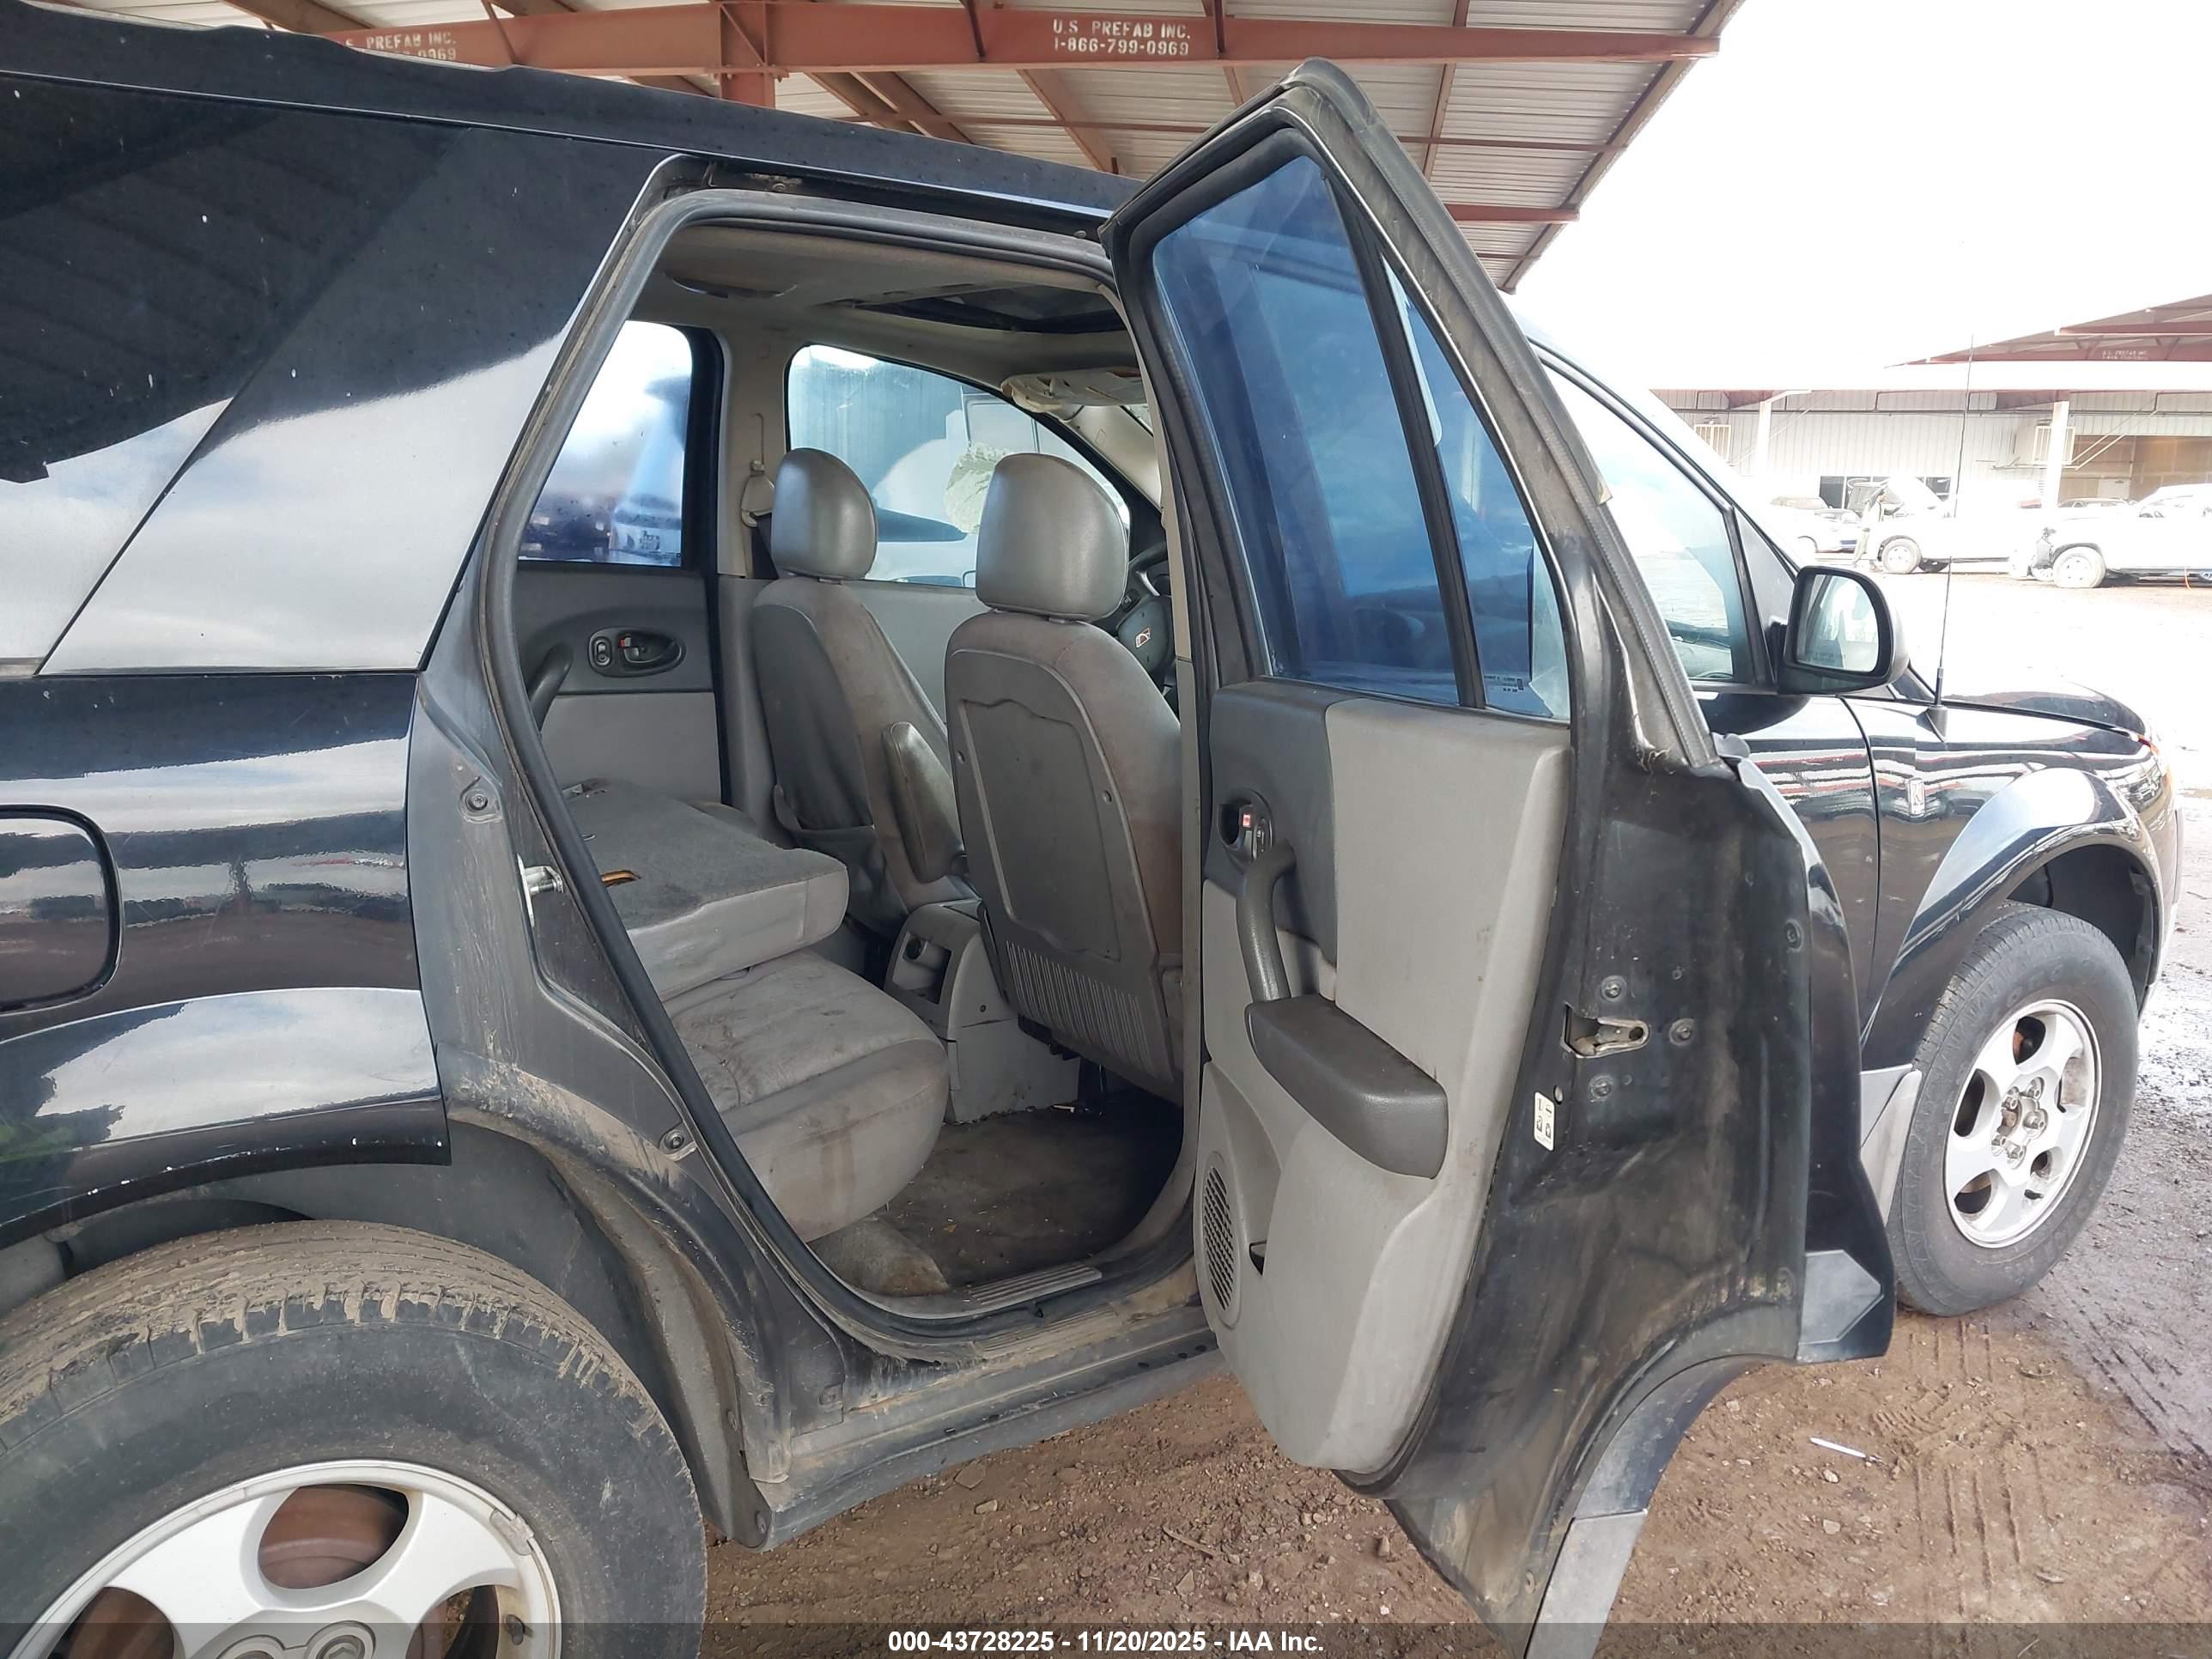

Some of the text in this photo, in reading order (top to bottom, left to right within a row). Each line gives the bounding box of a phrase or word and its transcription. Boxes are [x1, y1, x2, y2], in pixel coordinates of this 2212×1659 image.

[366, 33, 422, 49] PREFAB
[428, 31, 457, 45] INC.
[1091, 21, 1153, 38] PREFAB
[1161, 23, 1191, 40] INC.
[1054, 37, 1189, 56] 1-866-799-0969
